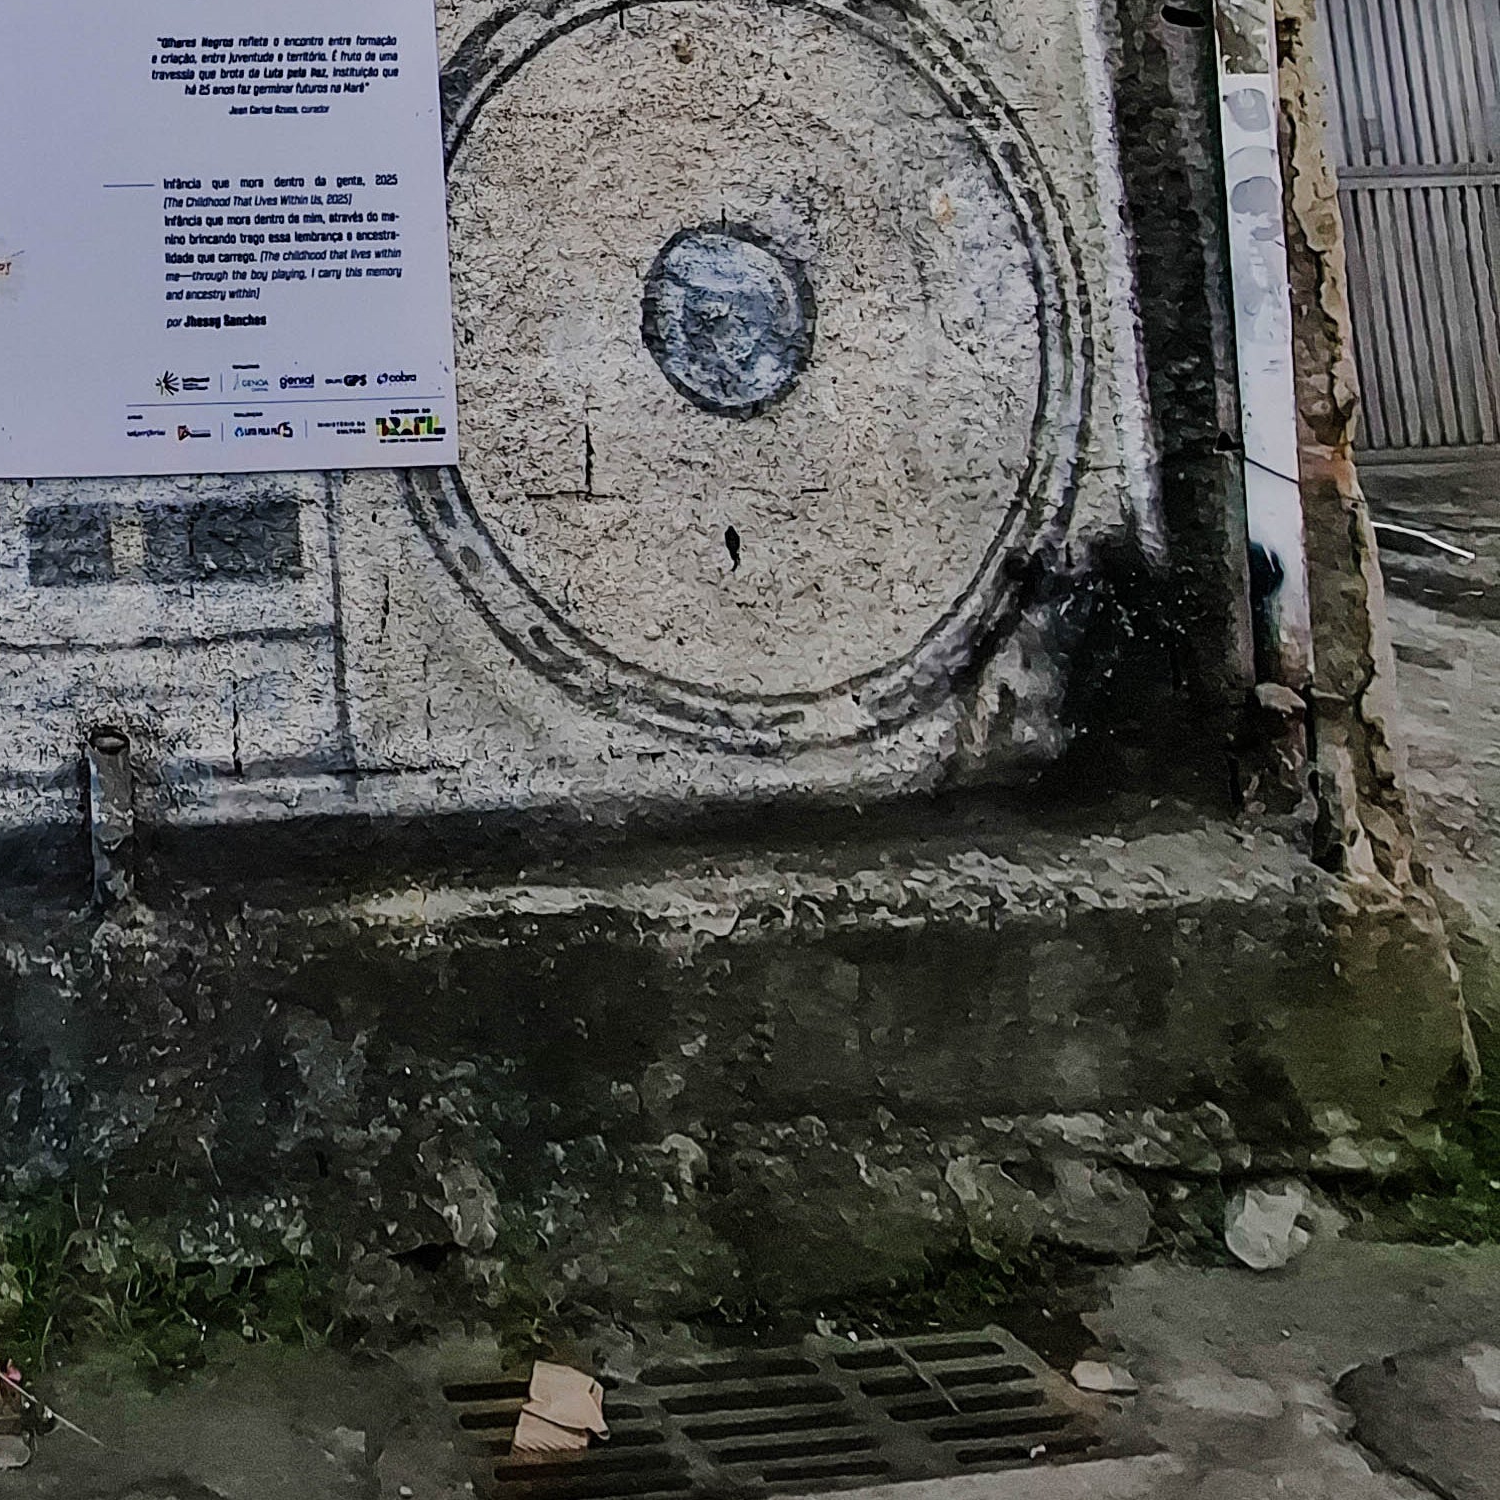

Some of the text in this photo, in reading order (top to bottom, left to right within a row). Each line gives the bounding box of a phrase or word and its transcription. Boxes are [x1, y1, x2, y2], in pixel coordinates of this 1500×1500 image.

[202, 37, 233, 48] Negros
[239, 36, 268, 47] reflete
[274, 38, 279, 46] o
[284, 37, 323, 46] encontro
[329, 37, 351, 46] entre
[356, 36, 397, 46] formação
[152, 55, 157, 63] e
[161, 54, 197, 64] criação,
[201, 54, 225, 63] entre
[229, 52, 274, 64] juventude
[287, 52, 327, 61] território.
[332, 49, 337, 61] É
[341, 52, 361, 61] fruto
[380, 53, 398, 61] uma
[152, 69, 194, 79] travessia
[199, 70, 216, 80] que
[220, 68, 244, 78] brota
[264, 67, 283, 78] Luta
[287, 67, 306, 79] pela
[383, 68, 398, 77] que
[185, 84, 196, 94] há
[213, 85, 234, 94] anos
[238, 84, 251, 94] faz
[254, 84, 294, 96] germinar
[296, 82, 327, 93] futuros
[330, 85, 341, 93] na
[301, 105, 330, 113] curador
[164, 174, 398, 190] Infância que mora dentro da gente, 2025
[186, 197, 231, 207] Childhood
[234, 196, 252, 206] That
[255, 196, 277, 205] Lives
[281, 195, 308, 205] Within
[311, 195, 323, 205] Us,
[165, 211, 399, 227] Infância que mora dentro de mim, através do me-
[165, 231, 400, 245] nino brincando trago essa lembrança e ancestra-
[165, 253, 194, 263] lidade
[198, 254, 214, 264] que
[219, 253, 257, 263] carrego.
[283, 250, 327, 260] childhood
[330, 250, 347, 259] that
[351, 249, 371, 259] lives
[375, 249, 401, 258] within
[233, 270, 247, 280] the
[251, 269, 268, 281] boy
[272, 269, 307, 280] playing,
[318, 269, 341, 279] carry
[346, 267, 362, 277] this
[366, 268, 402, 278] memory
[166, 289, 183, 300] and
[186, 289, 226, 300] ancestry
[167, 319, 182, 328] por
[224, 314, 266, 326] Sanches
[280, 374, 314, 389] genial
